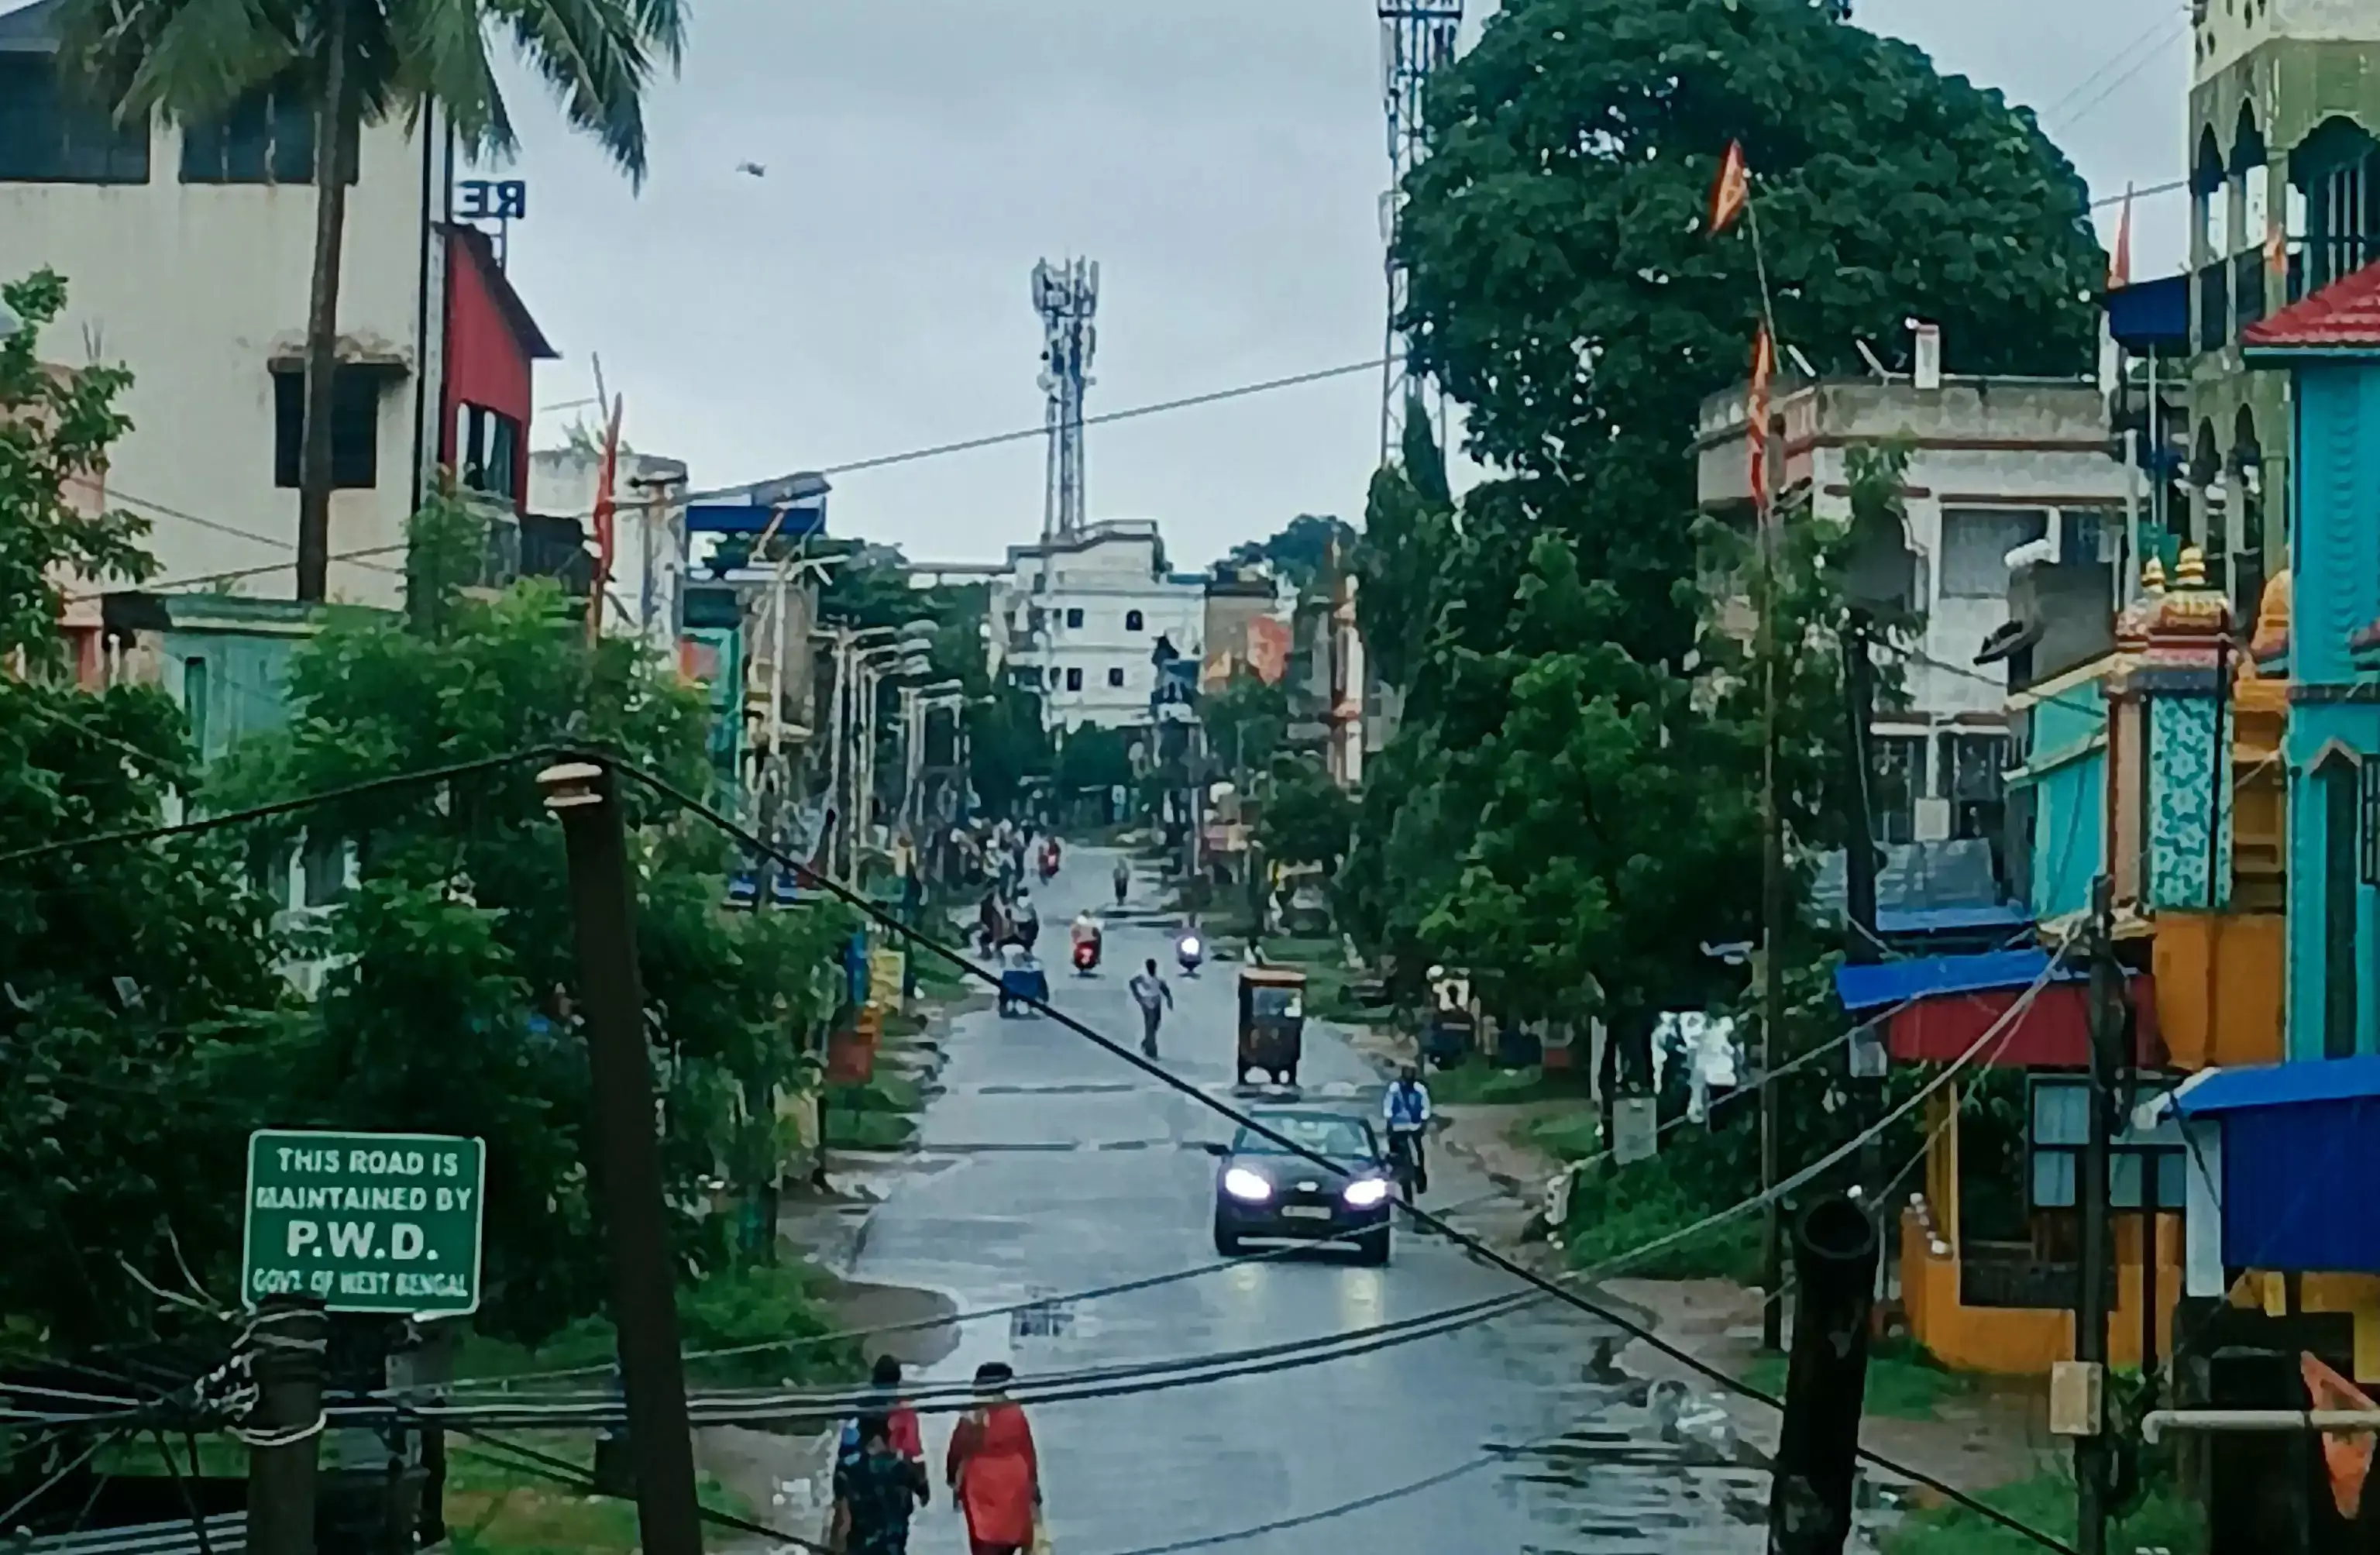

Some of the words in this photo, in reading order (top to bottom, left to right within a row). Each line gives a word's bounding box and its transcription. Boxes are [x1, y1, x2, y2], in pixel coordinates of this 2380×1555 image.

[277, 1147, 340, 1174] THIS
[349, 1150, 425, 1175] ROAD
[432, 1152, 459, 1176] IS
[256, 1186, 427, 1211] MAINTAINED
[435, 1187, 472, 1211] BY
[287, 1220, 439, 1261] P.W.D.
[340, 1271, 390, 1295] WEST
[395, 1272, 469, 1297] BENGAL
